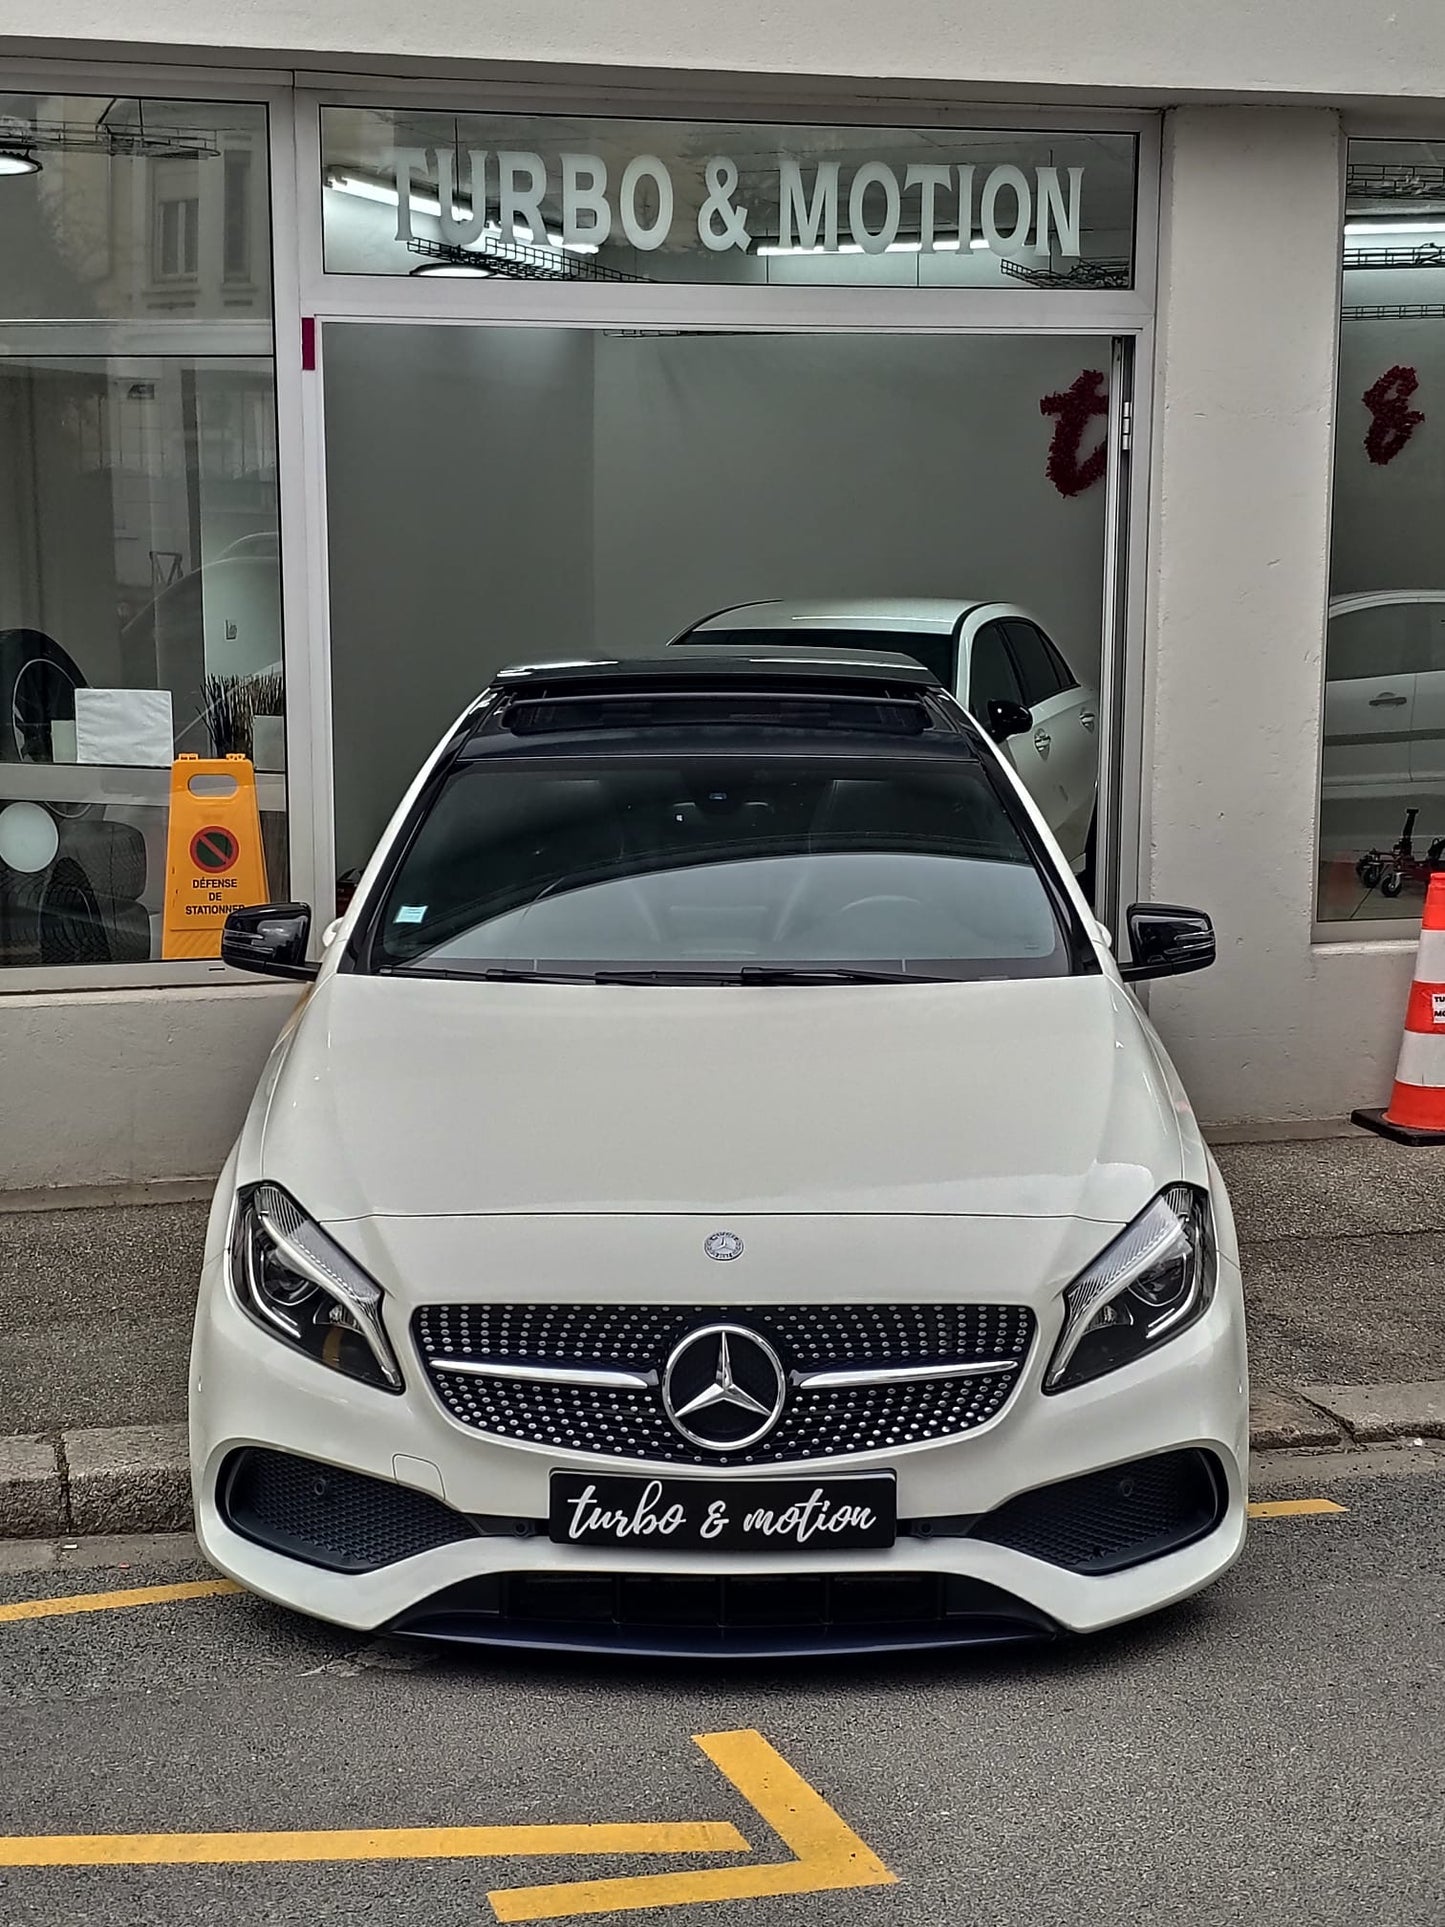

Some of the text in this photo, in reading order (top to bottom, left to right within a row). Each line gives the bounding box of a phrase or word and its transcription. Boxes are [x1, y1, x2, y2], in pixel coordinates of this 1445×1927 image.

[378, 147, 1085, 257] TURBO & MOTION
[192, 876, 238, 889] DÉFENSE
[208, 891, 223, 902] DE
[567, 1480, 877, 1543] turbo & motion
